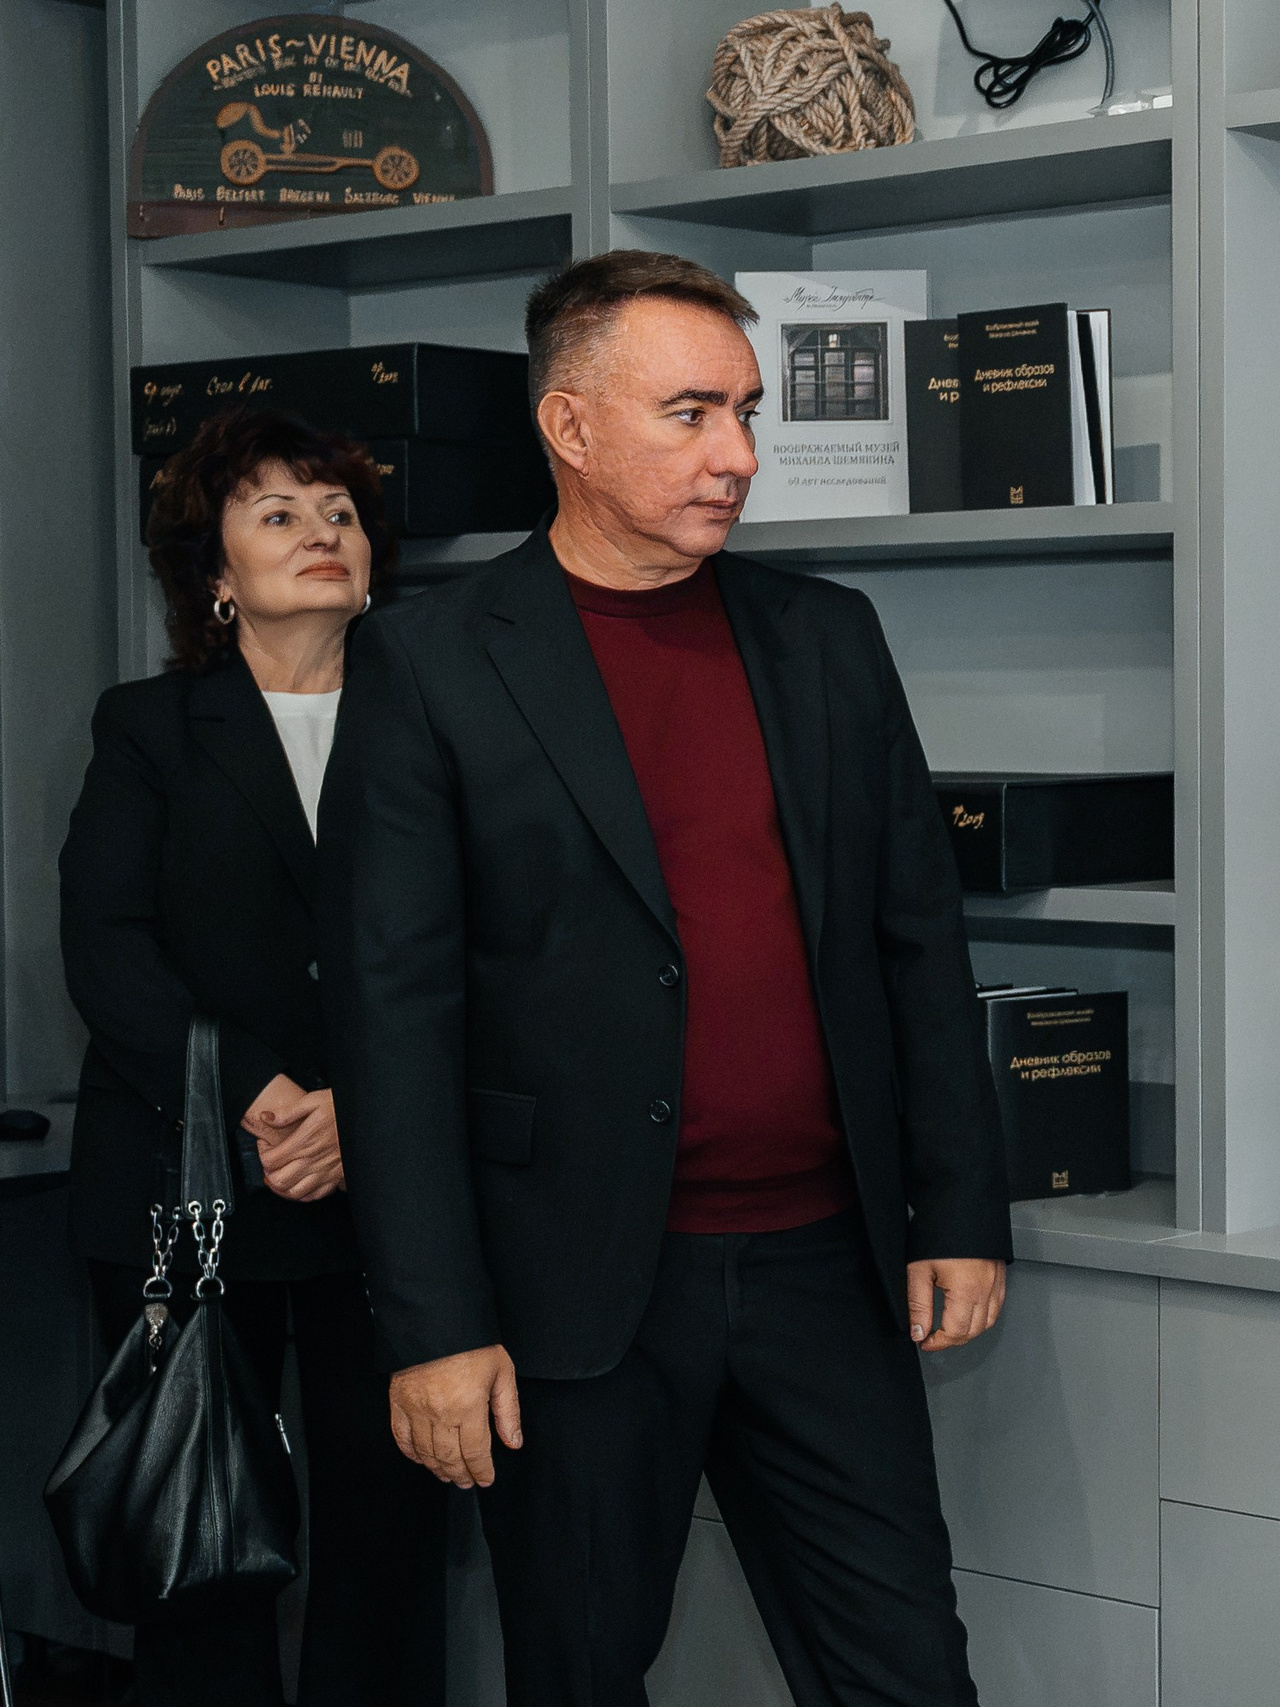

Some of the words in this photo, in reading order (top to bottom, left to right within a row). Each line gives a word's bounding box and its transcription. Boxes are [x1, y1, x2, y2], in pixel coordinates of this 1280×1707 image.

[254, 83, 296, 98] LOUIS
[303, 84, 364, 100] RENAULT
[974, 368, 1014, 382] Дневник
[1014, 363, 1055, 378] образов
[982, 383, 990, 393] и
[990, 378, 1047, 394] рефлексии
[939, 392, 948, 401] и
[1010, 1056, 1060, 1070] Дневник
[1061, 1049, 1112, 1065] образов
[1020, 1070, 1030, 1080] и
[1031, 1064, 1102, 1081] рефлексии
